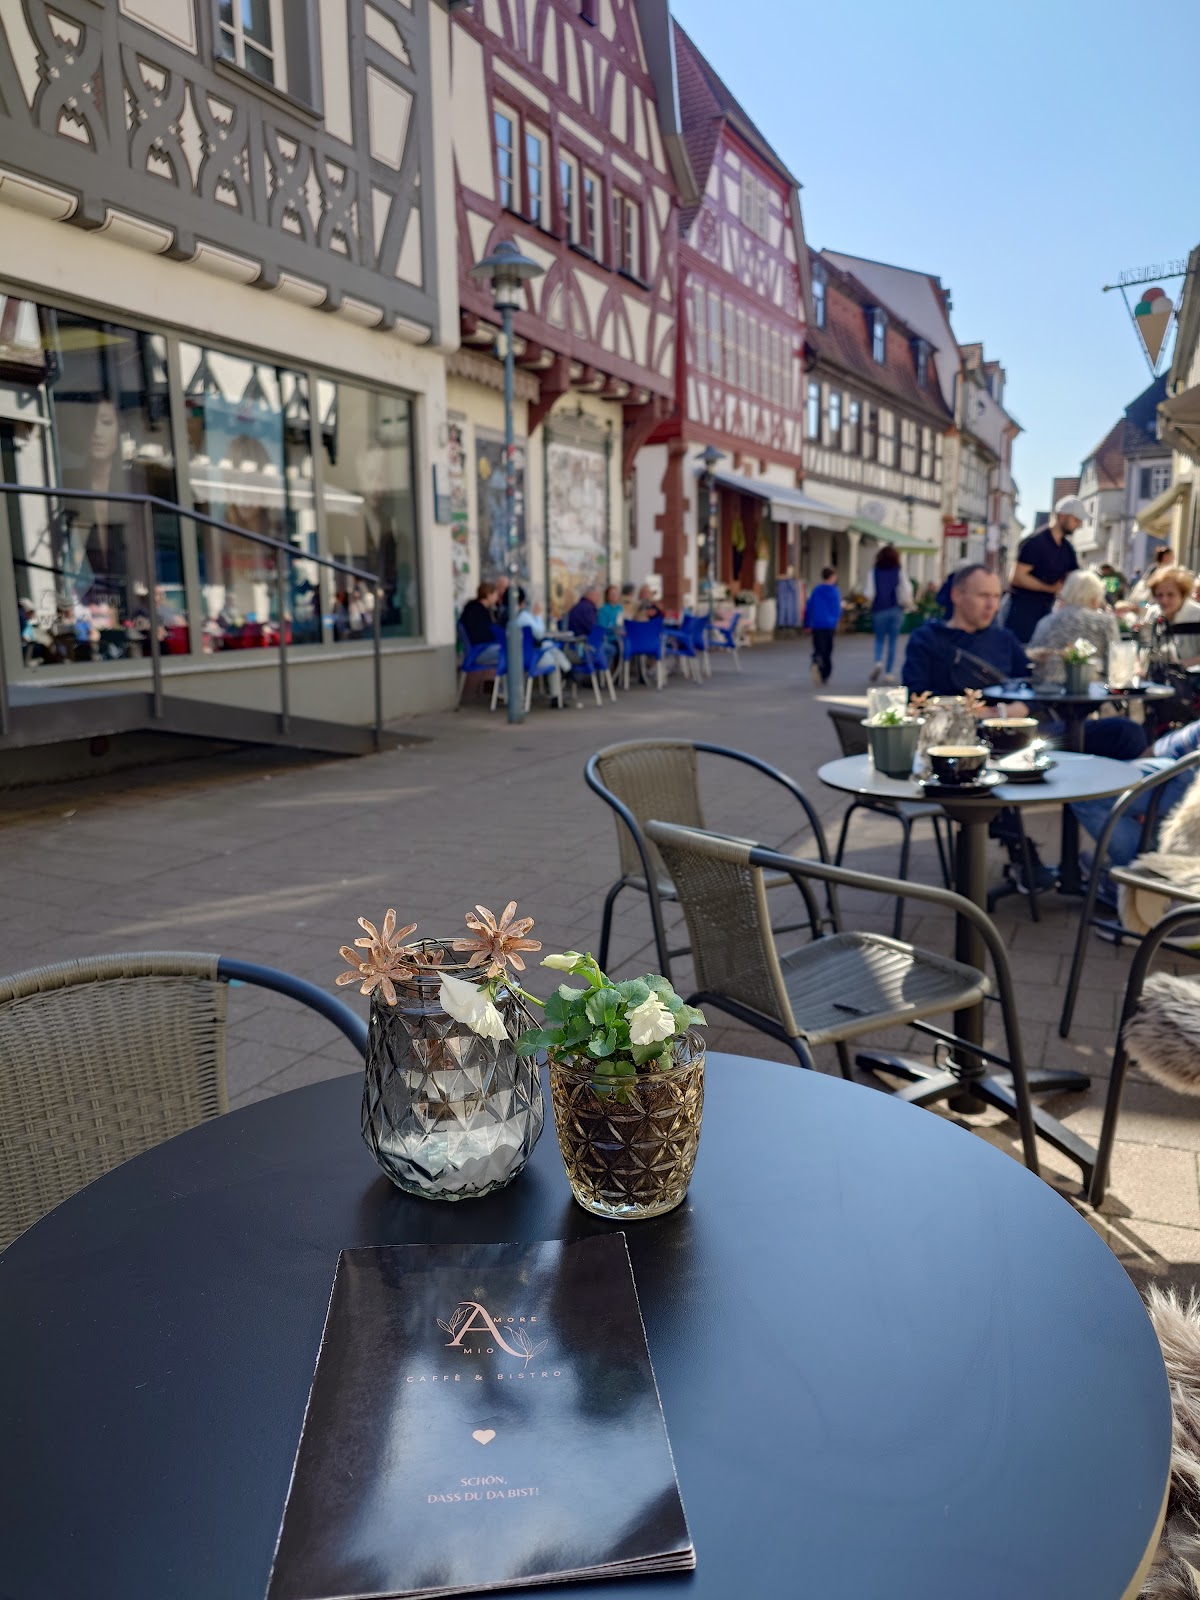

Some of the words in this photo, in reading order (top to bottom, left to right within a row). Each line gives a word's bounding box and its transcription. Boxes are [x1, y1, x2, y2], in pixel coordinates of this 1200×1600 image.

[497, 1370, 561, 1380] BISTRO
[428, 1493, 462, 1503] DASS
[464, 1492, 483, 1501] DU
[486, 1490, 505, 1500] DA
[508, 1487, 539, 1497] BIST!
